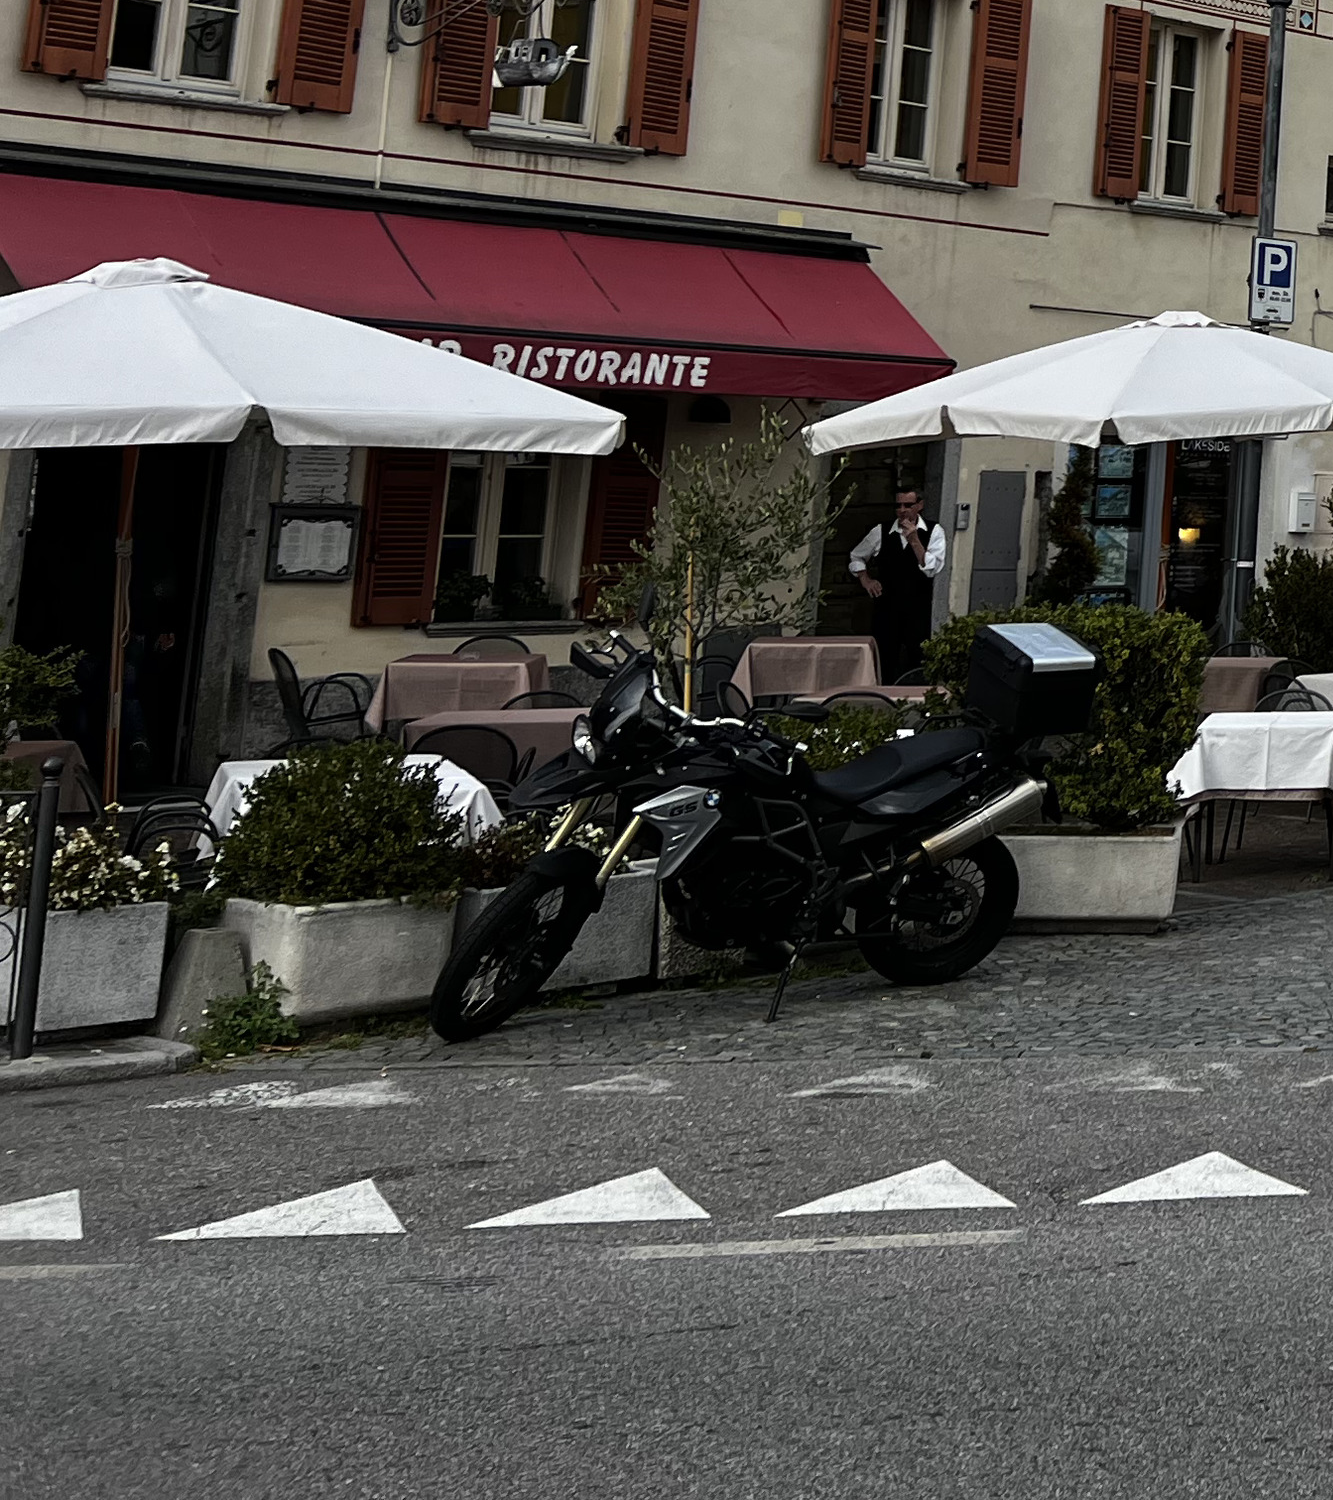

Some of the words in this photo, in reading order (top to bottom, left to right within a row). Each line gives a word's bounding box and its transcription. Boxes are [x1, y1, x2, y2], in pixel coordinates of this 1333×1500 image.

[1263, 247, 1288, 285] P
[492, 343, 711, 388] RISTORANTE
[670, 801, 699, 817] GS
